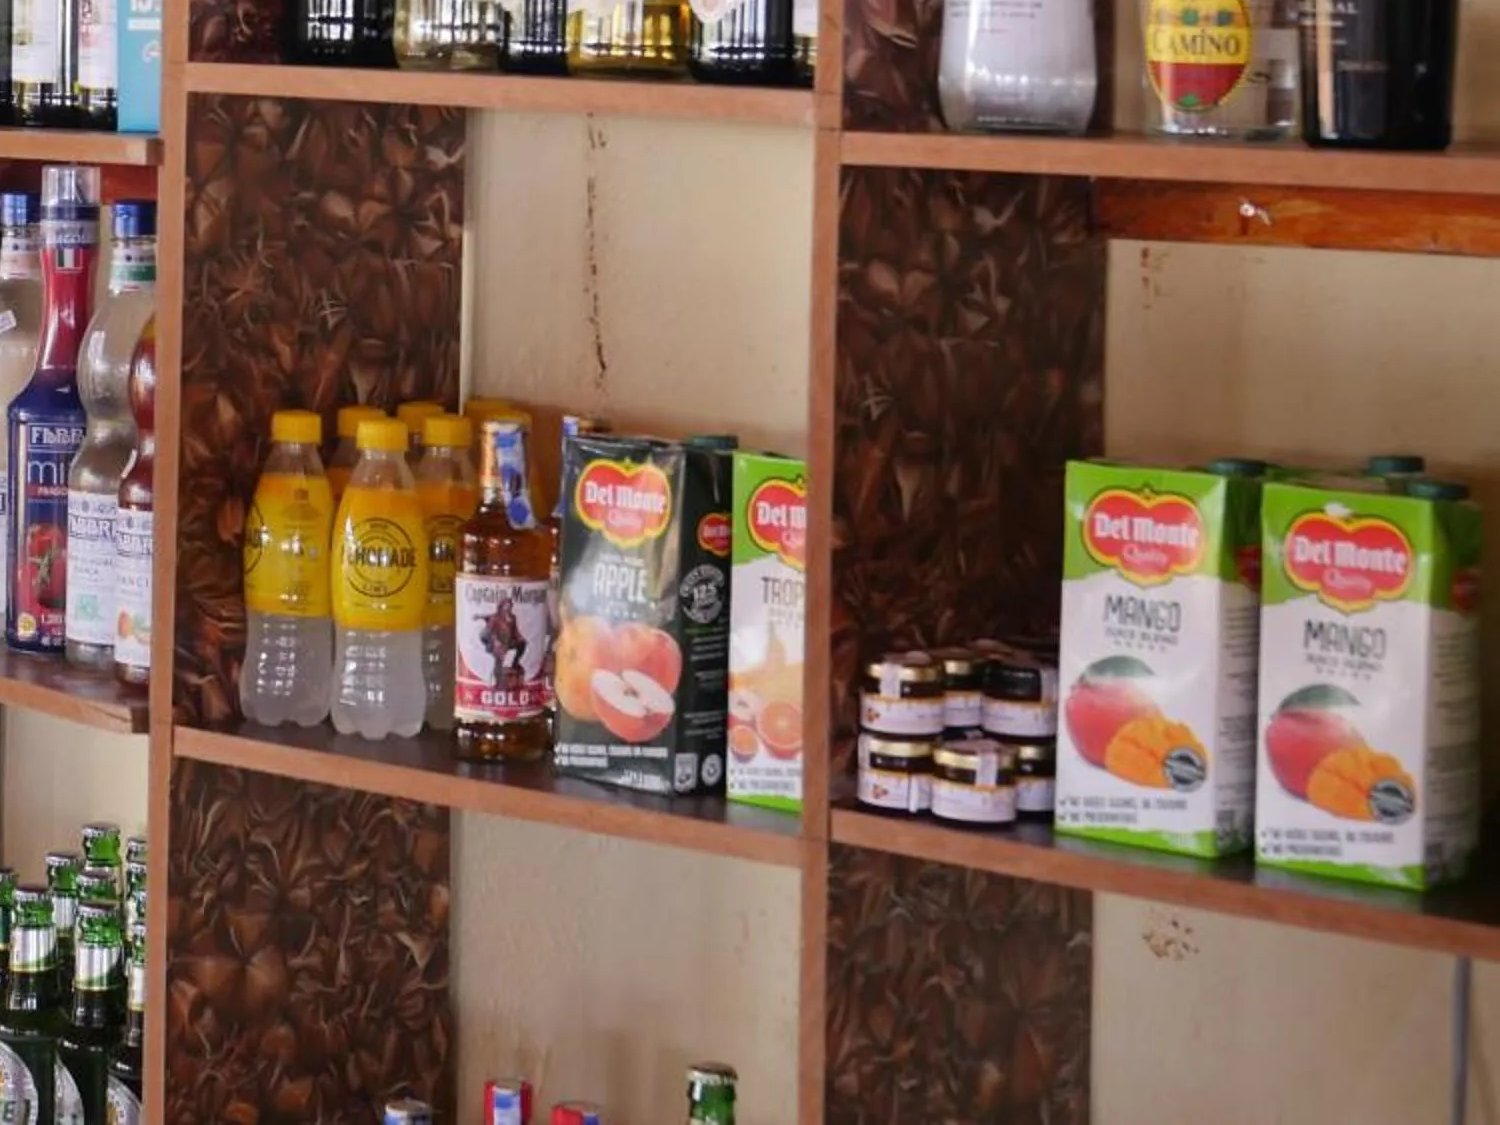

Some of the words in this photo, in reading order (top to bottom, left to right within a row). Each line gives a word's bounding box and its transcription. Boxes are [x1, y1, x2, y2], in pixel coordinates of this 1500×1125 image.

[755, 500, 788, 528] Del
[1093, 512, 1131, 541] Del
[1132, 516, 1200, 550] Monte
[1294, 535, 1331, 565] Del
[1333, 540, 1407, 575] Monte
[593, 562, 649, 604] APPLE
[1103, 594, 1182, 633] MANGO
[1303, 619, 1387, 660] MANGO
[480, 689, 530, 706] GOLD
